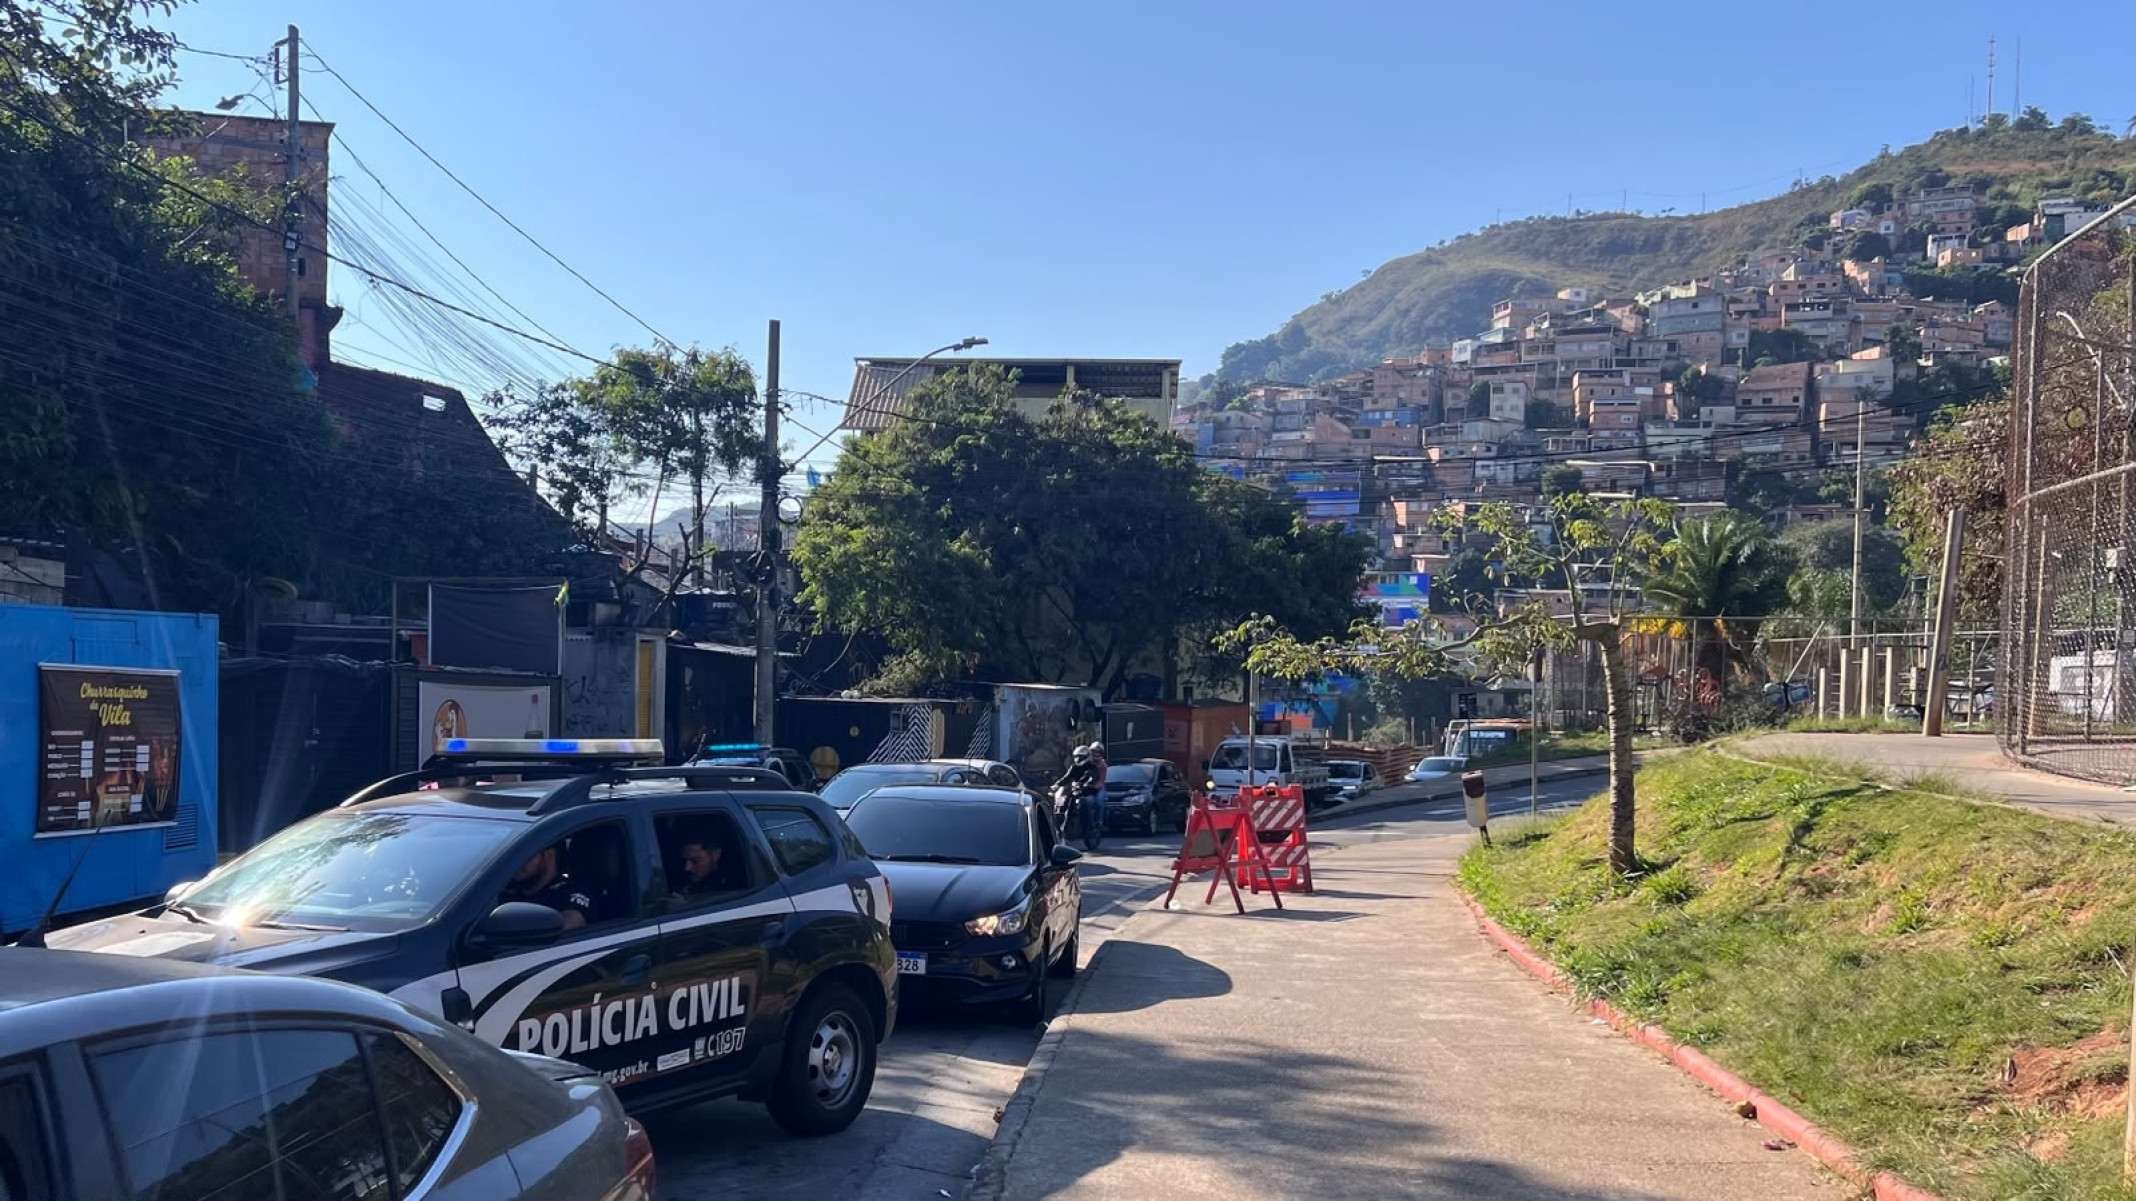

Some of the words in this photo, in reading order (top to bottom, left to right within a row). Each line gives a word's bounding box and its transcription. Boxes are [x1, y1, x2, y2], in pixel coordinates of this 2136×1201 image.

[80, 682, 148, 702] Churrasquinho
[98, 703, 131, 727] Vila
[518, 992, 658, 1058] POLÍCIA
[668, 976, 745, 1031] CIVIL
